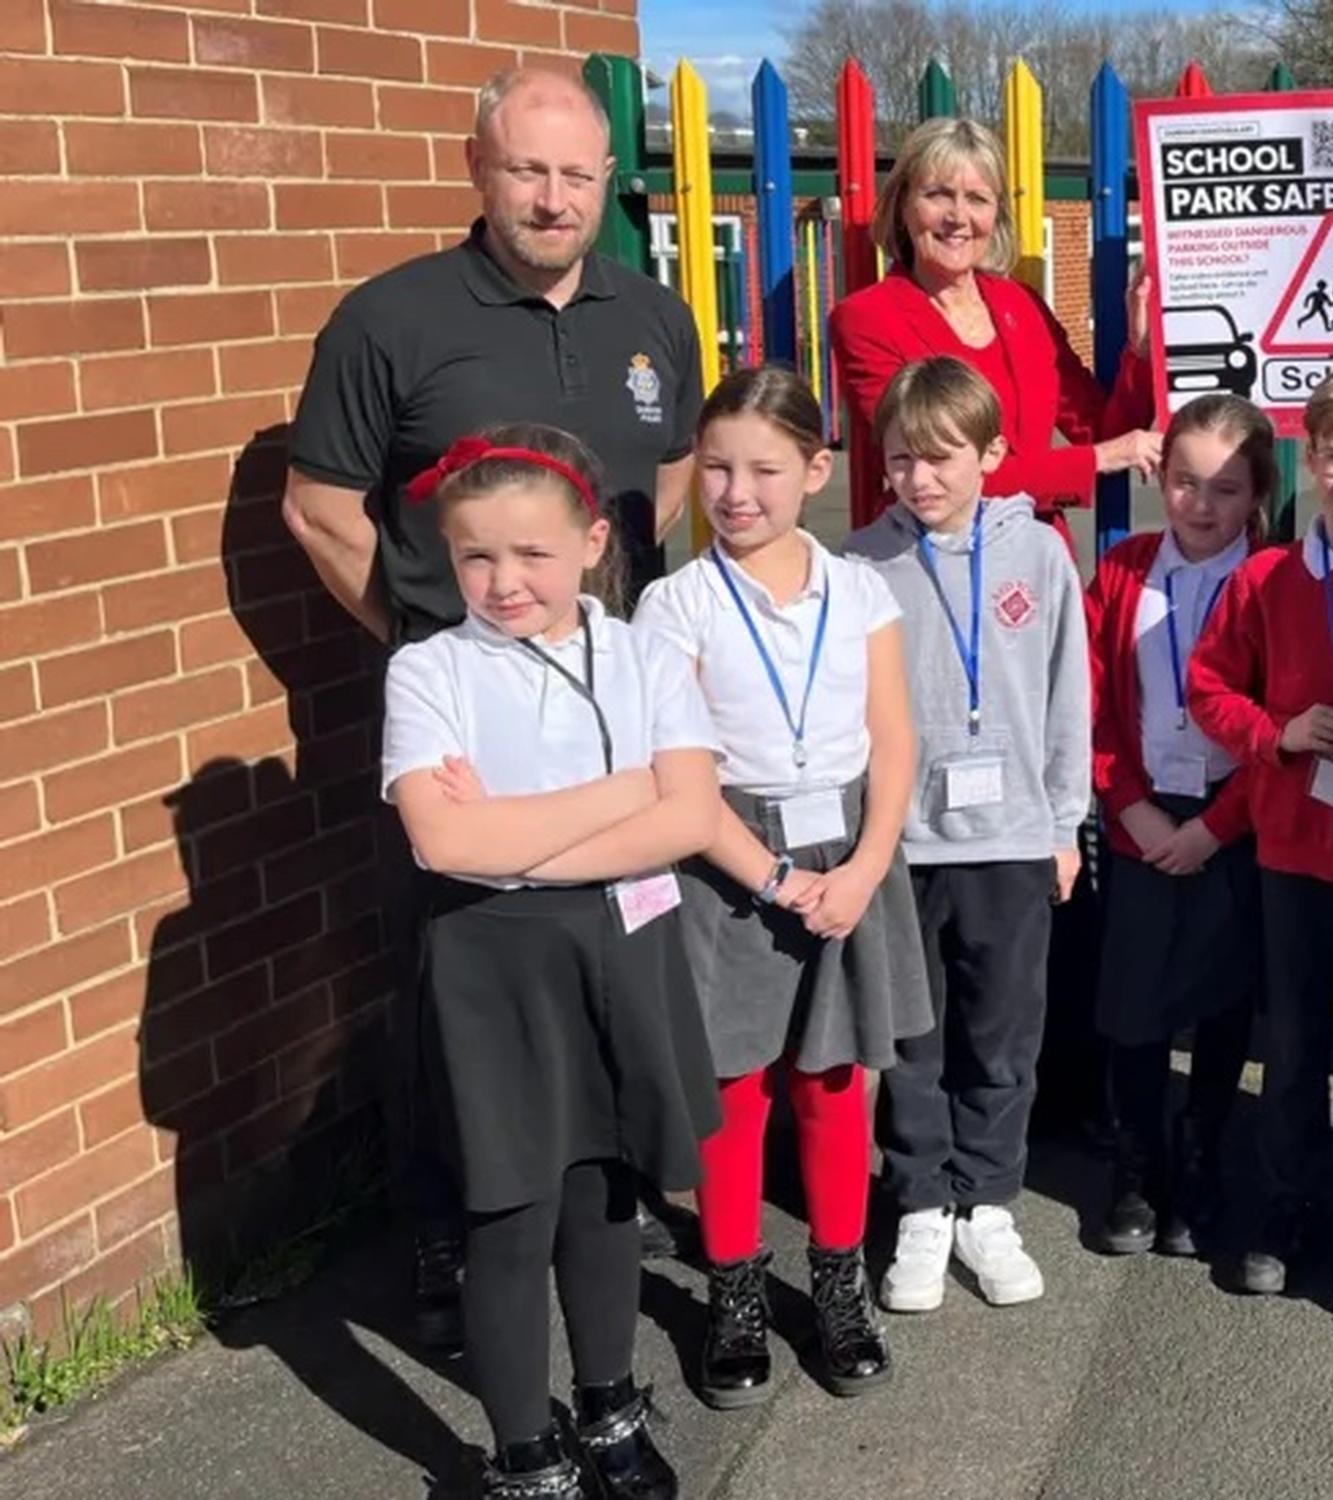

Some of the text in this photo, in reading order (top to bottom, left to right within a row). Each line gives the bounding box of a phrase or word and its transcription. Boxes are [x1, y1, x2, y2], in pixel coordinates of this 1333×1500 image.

[1166, 145, 1295, 175] SCHOOL
[1171, 184, 1258, 215] PARK
[1168, 224, 1308, 239] WITNESSED DANGEROUS
[1169, 240, 1269, 253] PARKING OUTSIDE
[1169, 254, 1250, 267] THIS SCHOOL?
